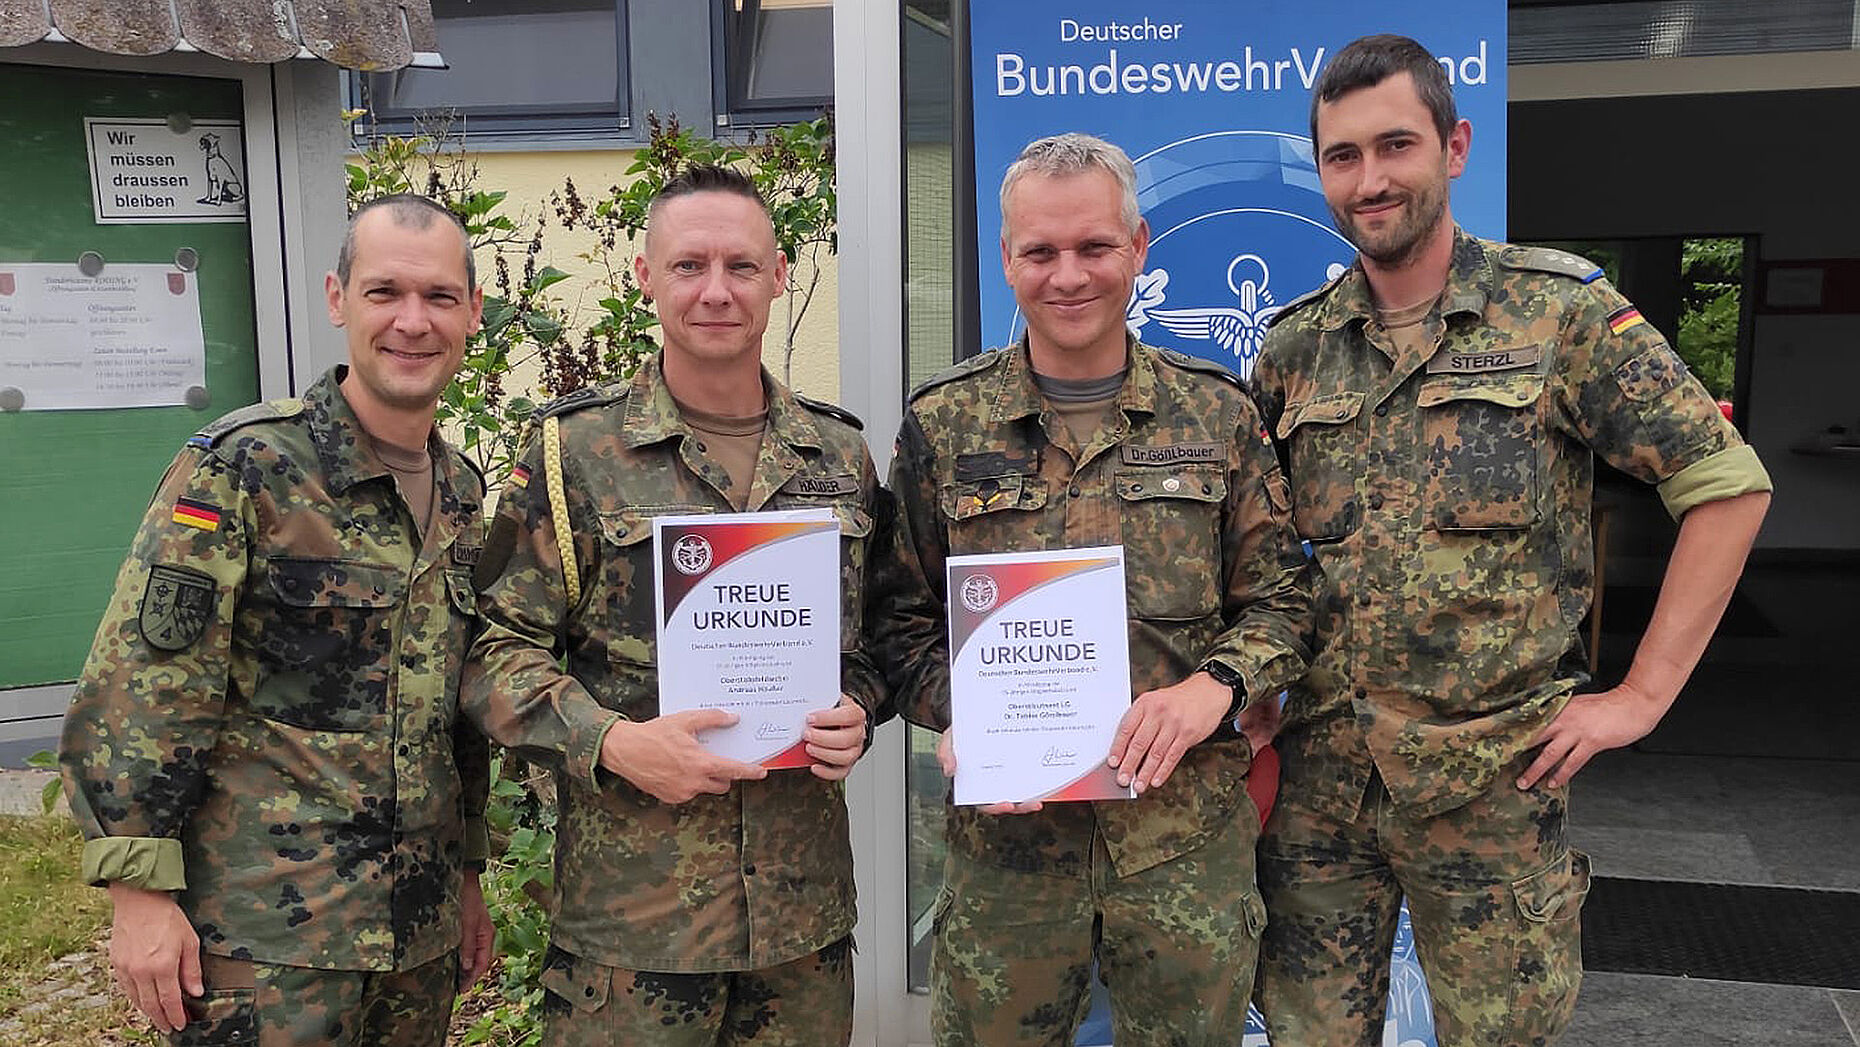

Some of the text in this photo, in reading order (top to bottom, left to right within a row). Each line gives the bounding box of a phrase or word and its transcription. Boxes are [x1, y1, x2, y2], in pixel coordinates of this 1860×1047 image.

[1060, 17, 1182, 42] Deutscher
[996, 41, 1487, 96] BundeswehrVnd
[106, 131, 135, 145] Wir
[110, 152, 175, 167] müssen
[112, 173, 189, 187] draussen
[115, 194, 175, 207] bleiben
[1451, 353, 1515, 369] STERZL
[713, 584, 790, 603] TREUE
[693, 608, 812, 630] URKUNDE
[999, 619, 1074, 639] TREUE
[981, 642, 1096, 665] URKUNDE
